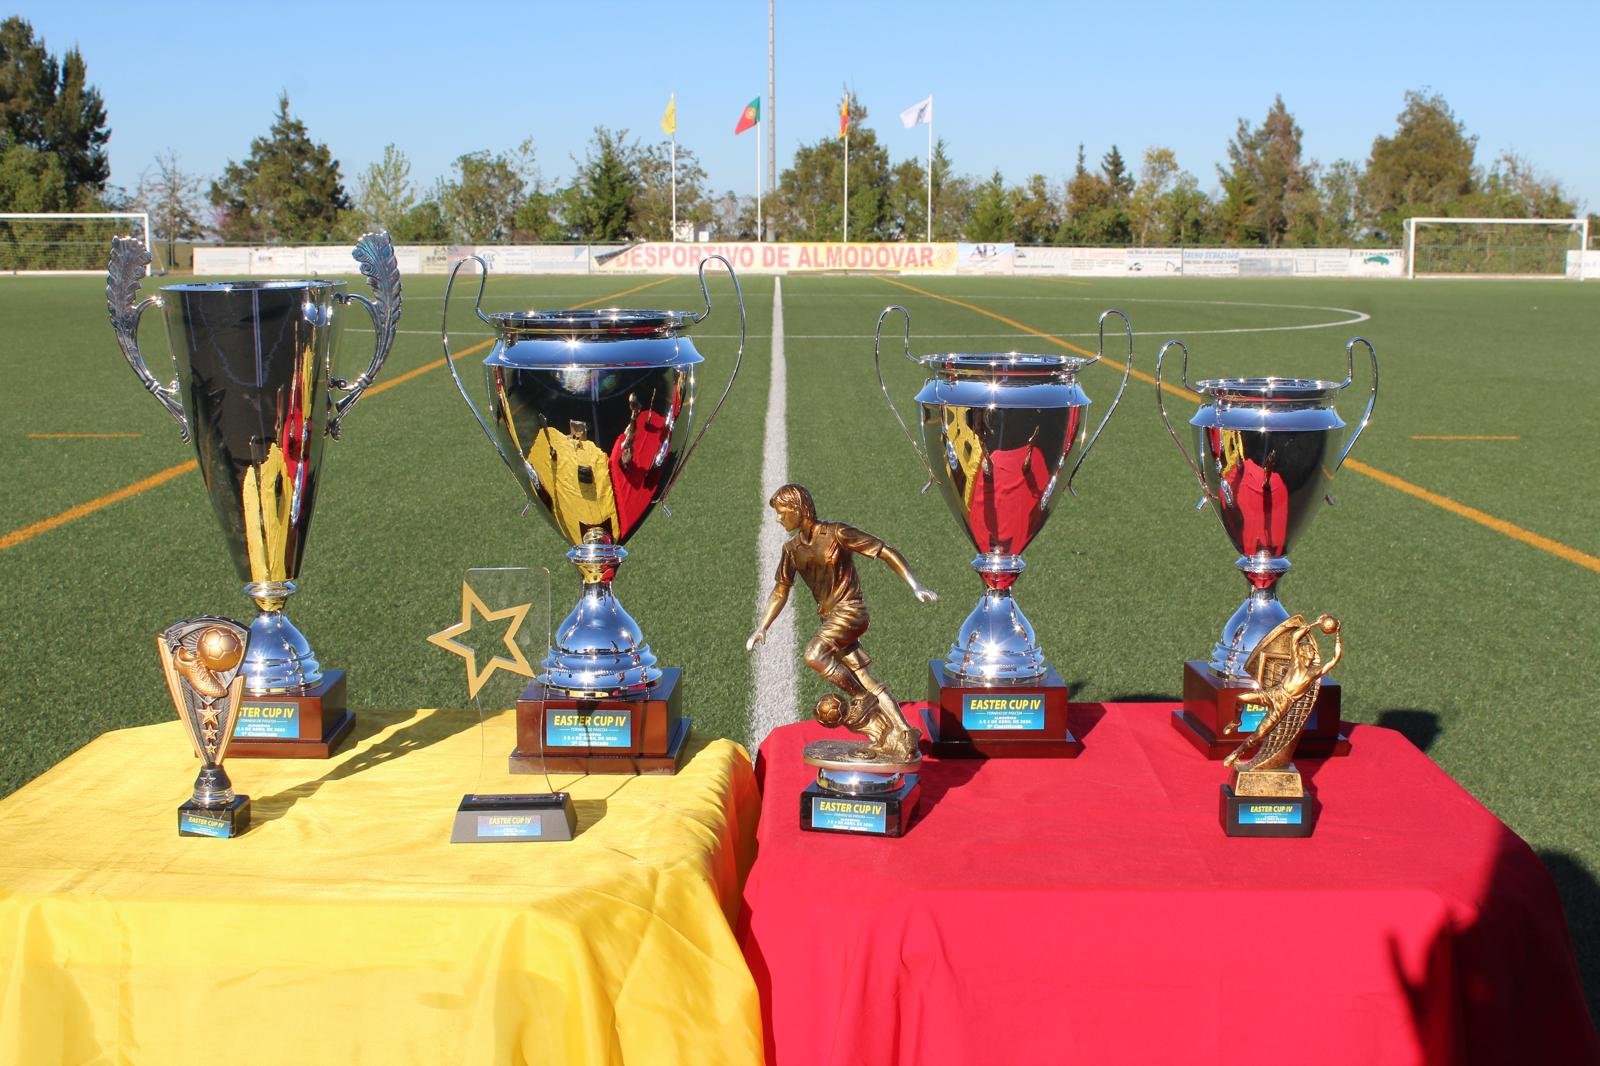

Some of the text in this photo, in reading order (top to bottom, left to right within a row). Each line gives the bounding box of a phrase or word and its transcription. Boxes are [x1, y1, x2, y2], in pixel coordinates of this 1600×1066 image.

[616, 246, 754, 268] DESPORTIVO
[762, 246, 789, 268] DE
[970, 699, 1041, 710] EASTER CUP IV
[261, 707, 283, 718] CUP
[283, 708, 295, 719] IV
[553, 714, 627, 727] EASTER CUP IV
[820, 800, 882, 815] EASTER CUP IV
[1250, 805, 1273, 813] EASTER
[1273, 805, 1286, 813] CUP
